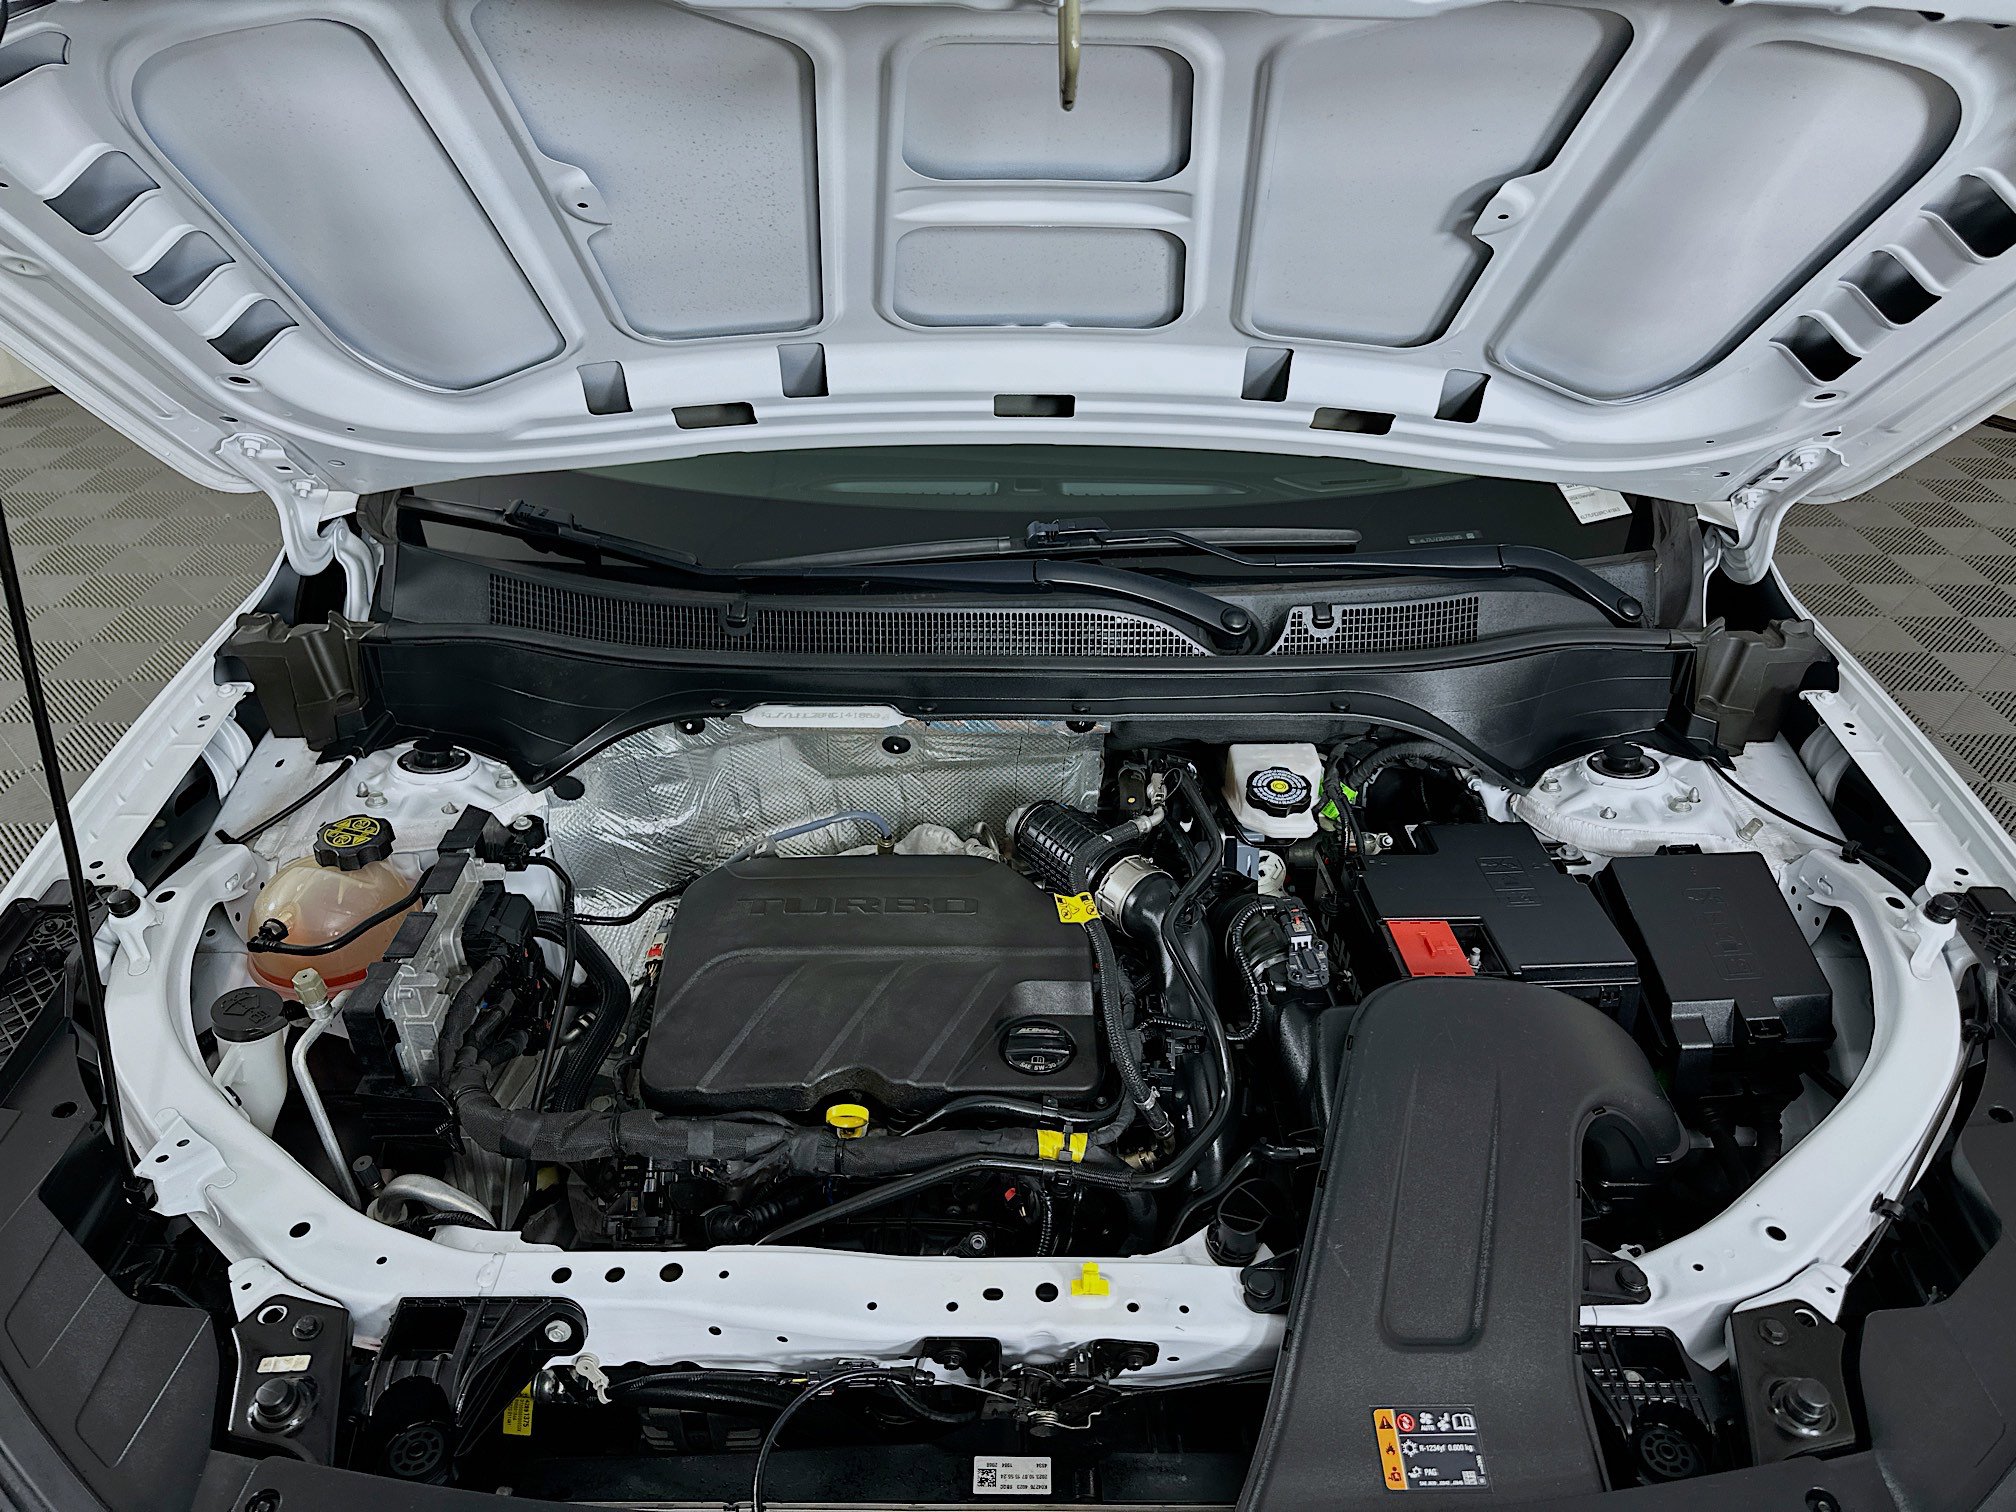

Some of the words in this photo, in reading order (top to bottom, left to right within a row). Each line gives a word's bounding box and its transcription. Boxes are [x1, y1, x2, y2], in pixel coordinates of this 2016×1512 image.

[737, 897, 979, 915] TURBO
[1019, 1062, 1032, 1070] SAE
[1034, 1062, 1057, 1071] 5W-30
